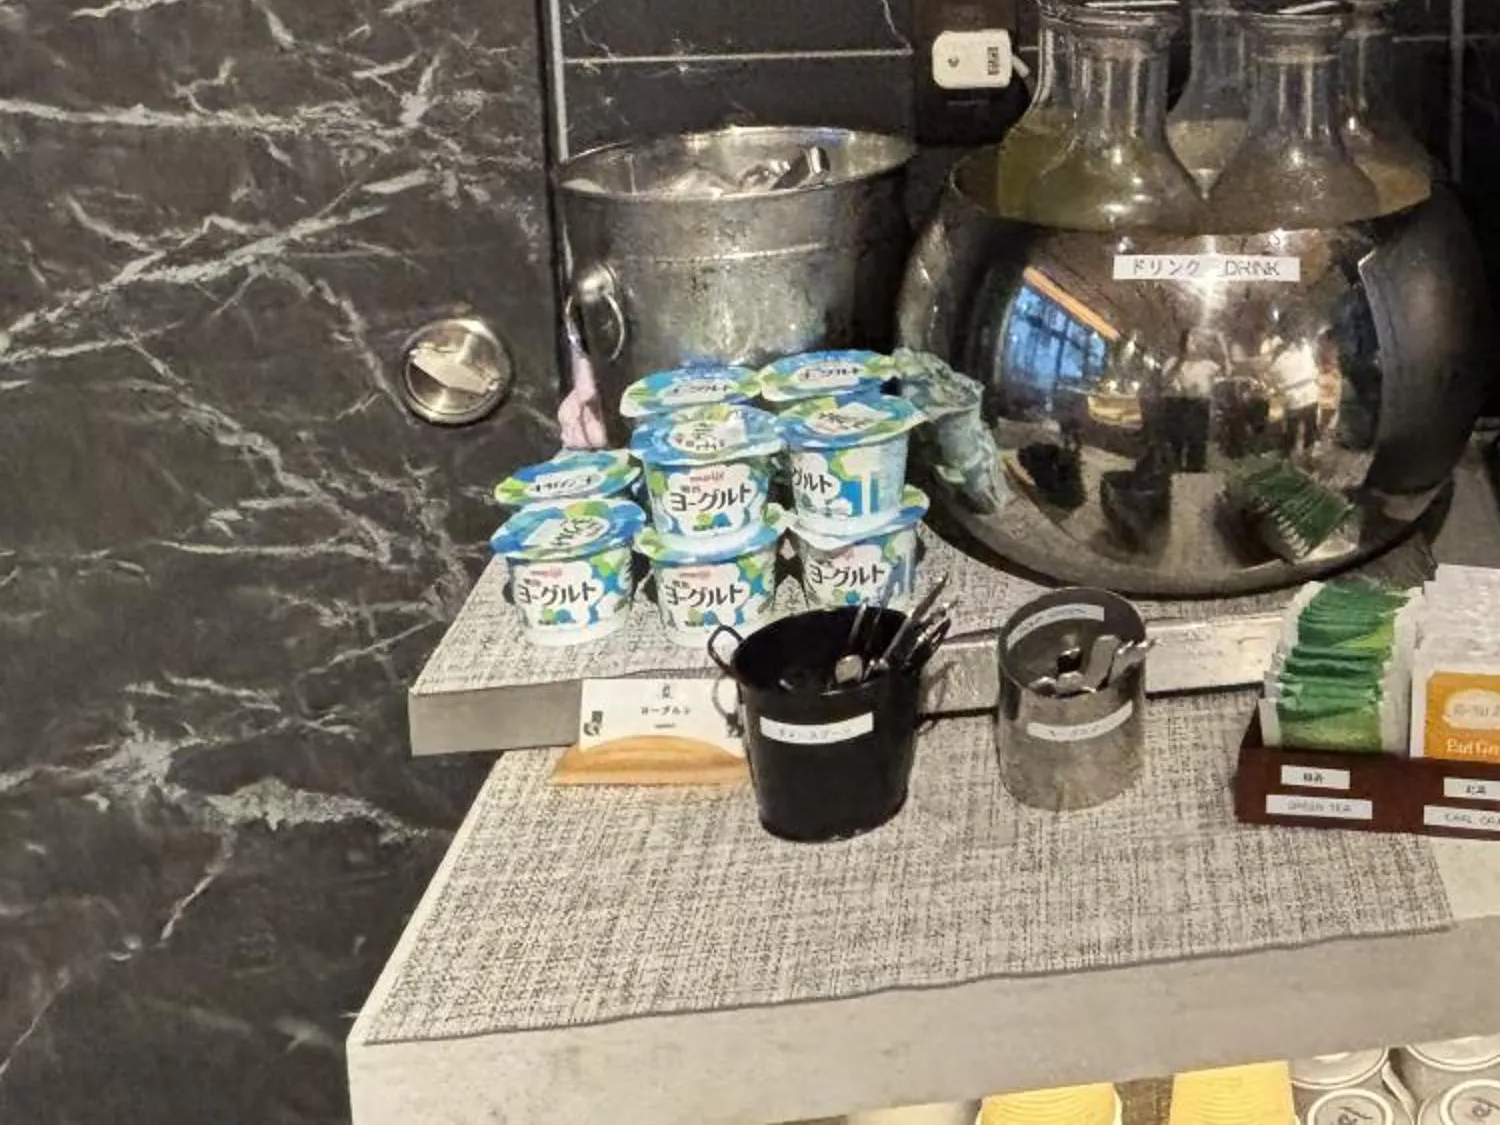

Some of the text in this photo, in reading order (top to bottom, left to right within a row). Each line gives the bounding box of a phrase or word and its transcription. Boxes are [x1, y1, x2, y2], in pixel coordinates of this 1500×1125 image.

[1134, 259, 1201, 275] ドリンク
[670, 482, 752, 512] ヨーグルト
[811, 564, 886, 586] ヨーグルト
[518, 581, 597, 606] ヨーグルト
[664, 582, 743, 608] ヨーグルト
